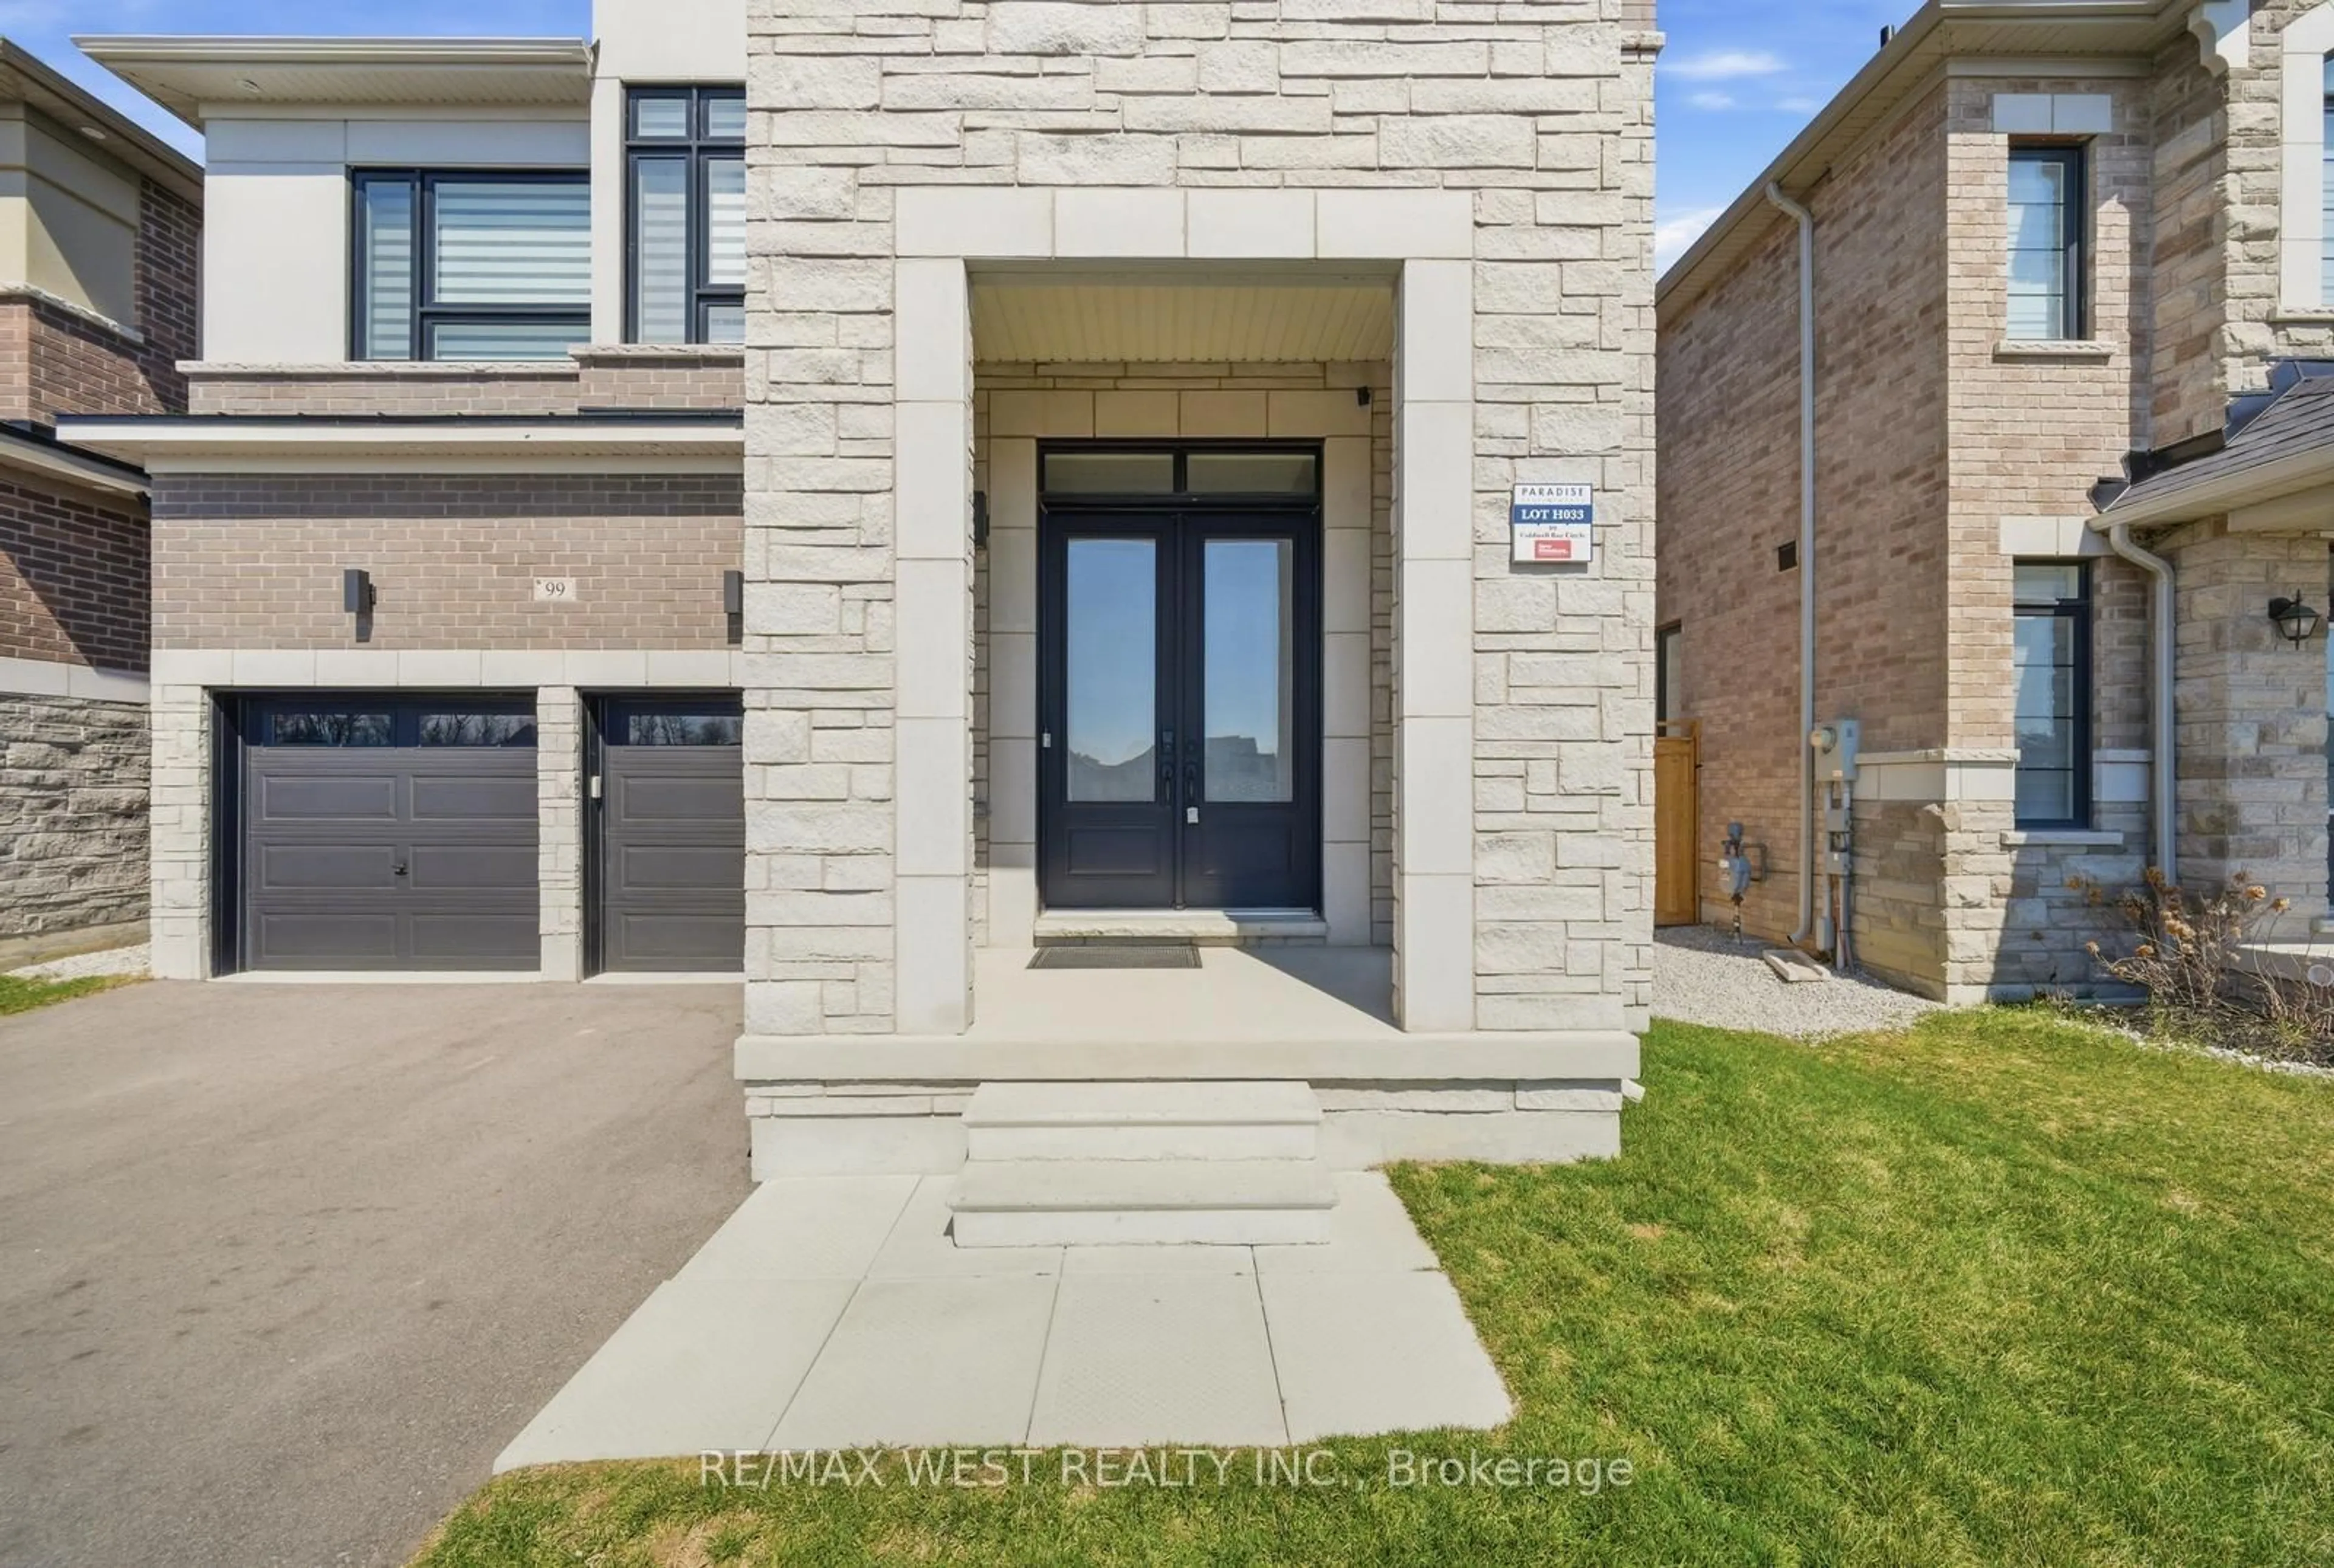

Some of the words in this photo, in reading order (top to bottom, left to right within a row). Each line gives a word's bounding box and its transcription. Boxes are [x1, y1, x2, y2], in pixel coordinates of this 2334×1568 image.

[1521, 487, 1584, 497] PARADISE
[1521, 509, 1549, 520] LOT
[1552, 509, 1584, 521] H033
[545, 582, 565, 596] 99
